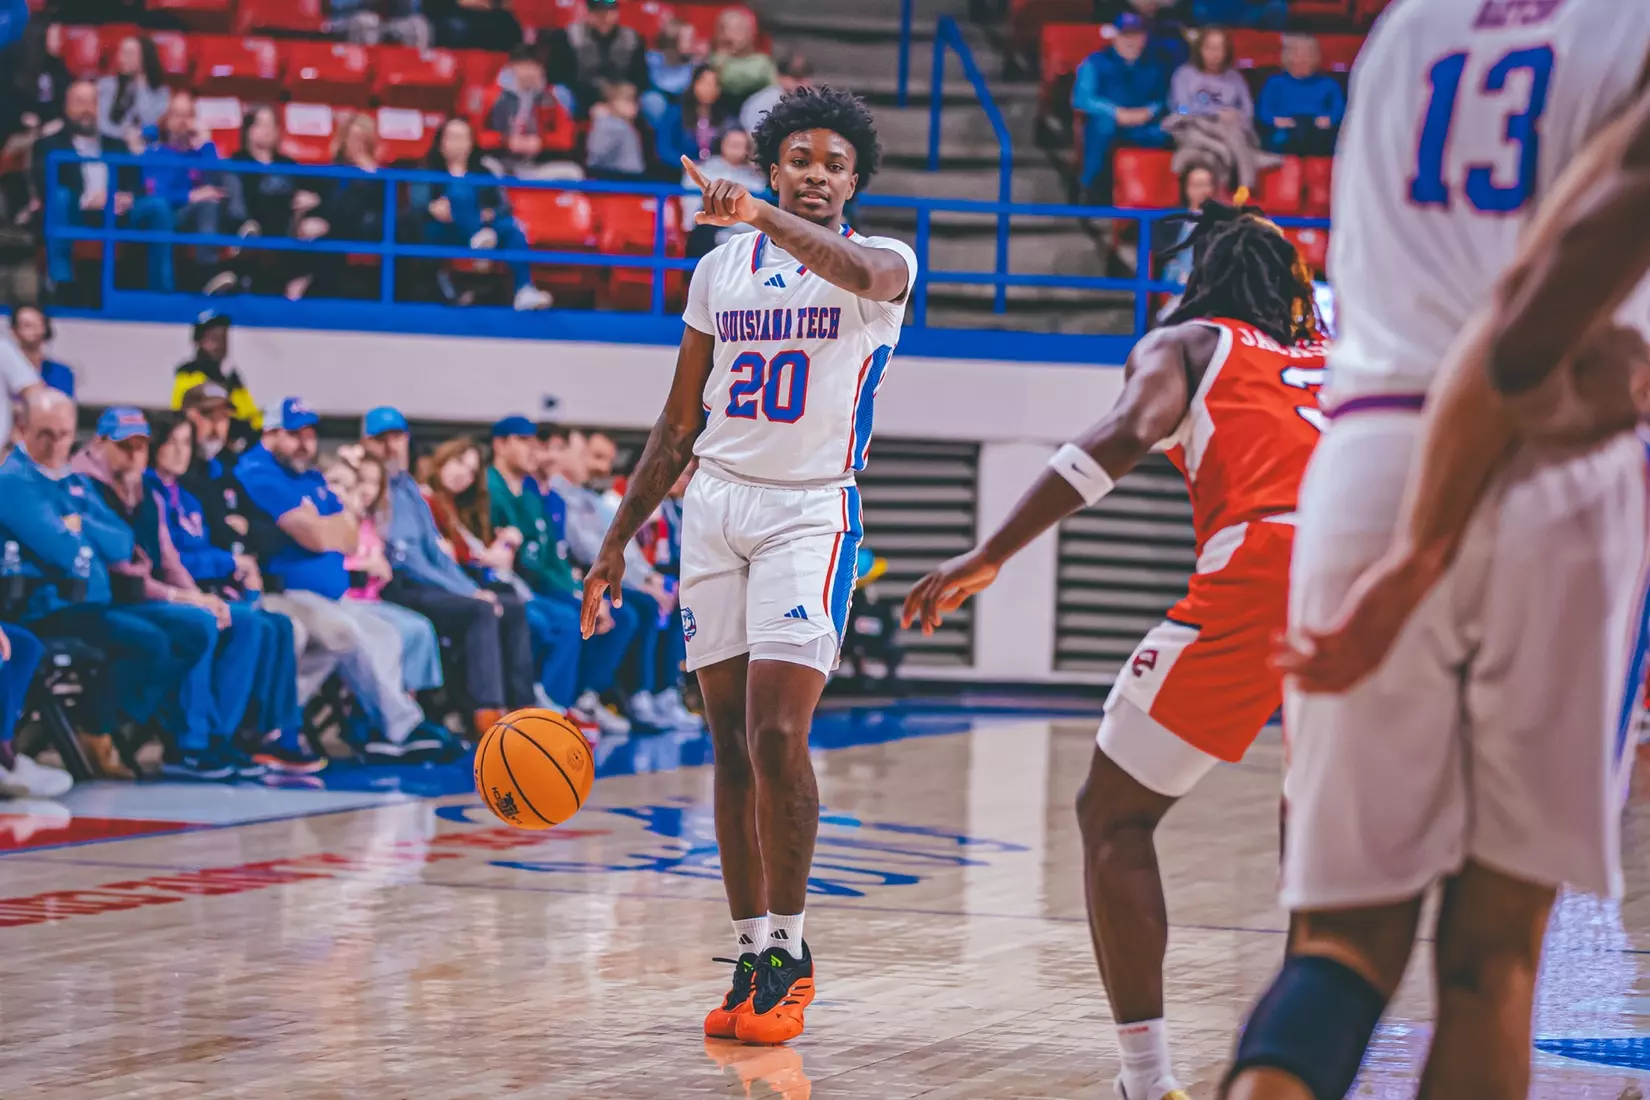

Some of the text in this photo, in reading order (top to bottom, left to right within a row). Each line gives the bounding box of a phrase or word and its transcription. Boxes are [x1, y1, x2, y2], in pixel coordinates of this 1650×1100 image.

[1405, 43, 1554, 213] 13
[715, 306, 842, 343] LOUISIANA TECH
[725, 349, 811, 424] 20
